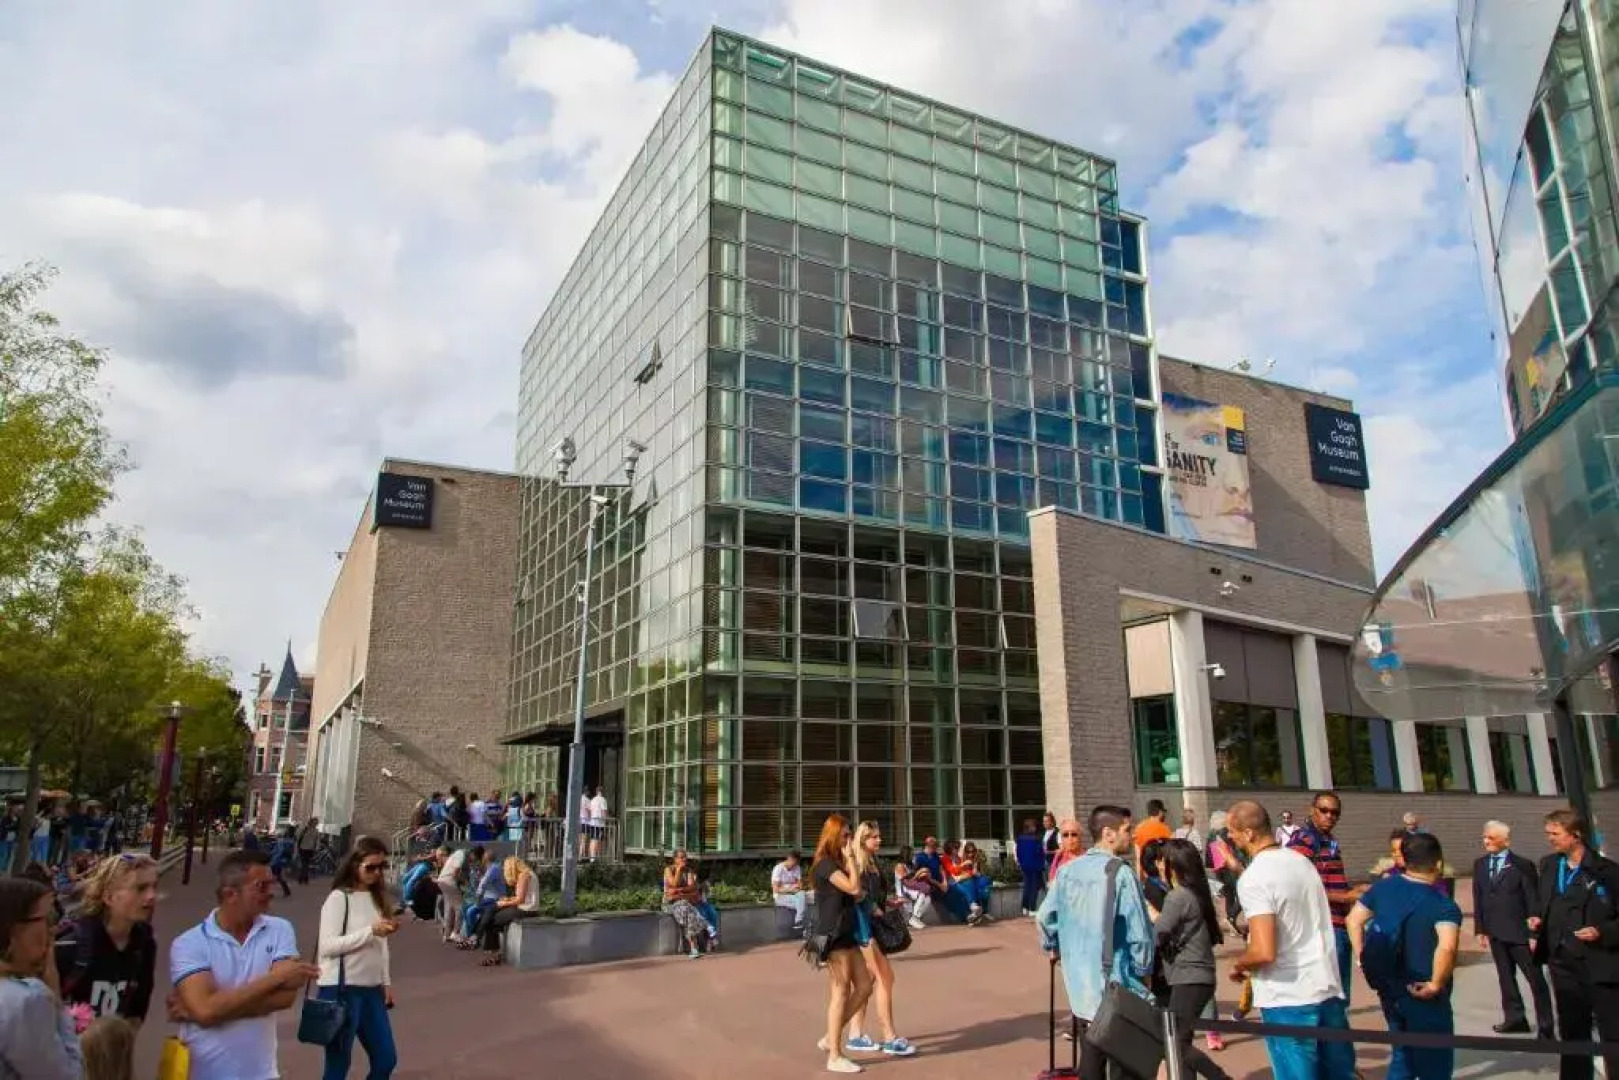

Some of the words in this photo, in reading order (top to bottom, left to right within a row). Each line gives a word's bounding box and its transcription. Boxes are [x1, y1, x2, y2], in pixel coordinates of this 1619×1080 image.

[1335, 417, 1356, 433] Van
[1330, 430, 1358, 447] Gogh
[1317, 441, 1359, 461] Museum
[407, 481, 426, 492] Van
[383, 497, 425, 510] Museum
